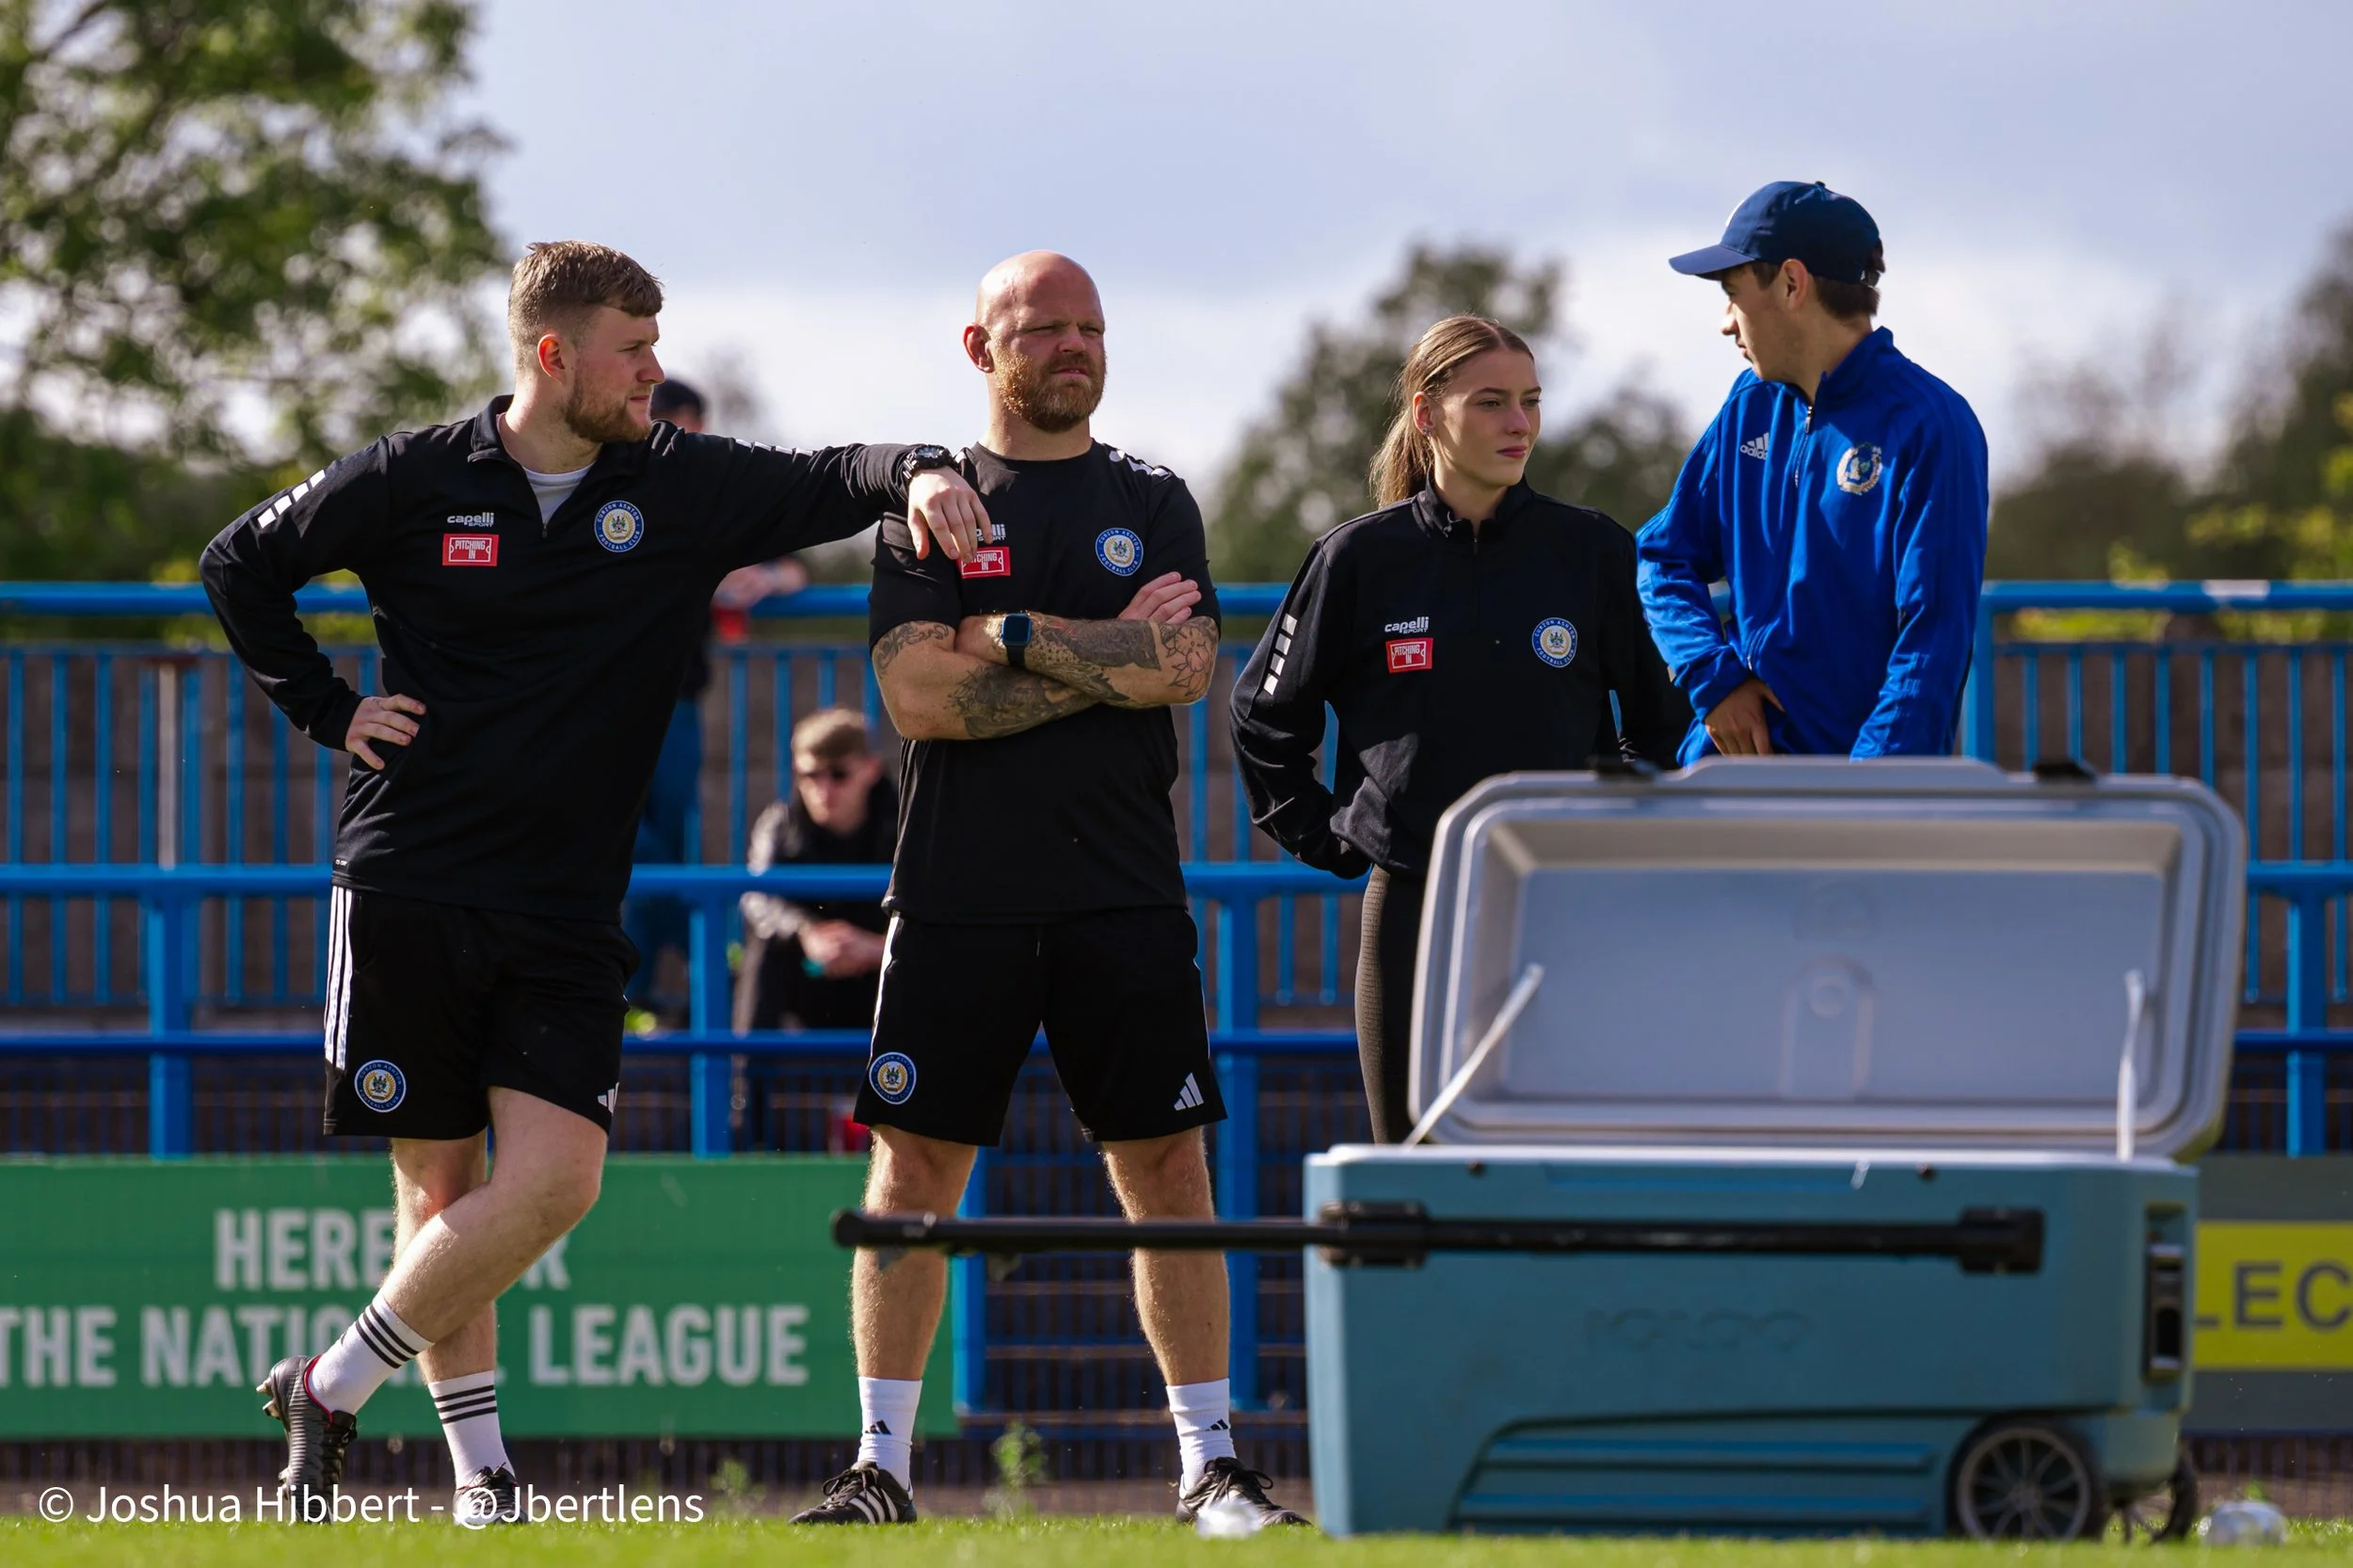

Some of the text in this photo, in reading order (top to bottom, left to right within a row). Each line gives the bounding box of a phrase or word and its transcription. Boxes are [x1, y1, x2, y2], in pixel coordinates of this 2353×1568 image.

[447, 511, 495, 525] capelli
[597, 503, 640, 522] CURZON ASHTON
[455, 539, 486, 551] PITCHING
[599, 531, 640, 551] FOOTBALL CLUB
[1098, 530, 1141, 551] CURZON ASHTON
[468, 549, 476, 560] IN
[1099, 553, 1127, 573] FOOTBALL
[982, 561, 989, 570] IN
[1385, 616, 1430, 633] capelli
[1534, 620, 1577, 639] CURZON ASHTON
[1394, 644, 1421, 656] PITCHING
[1536, 648, 1575, 665] FOOTBALL CLUB
[1405, 654, 1413, 664] IN
[213, 1208, 396, 1291] HERE
[528, 1303, 808, 1387] LEAGUE
